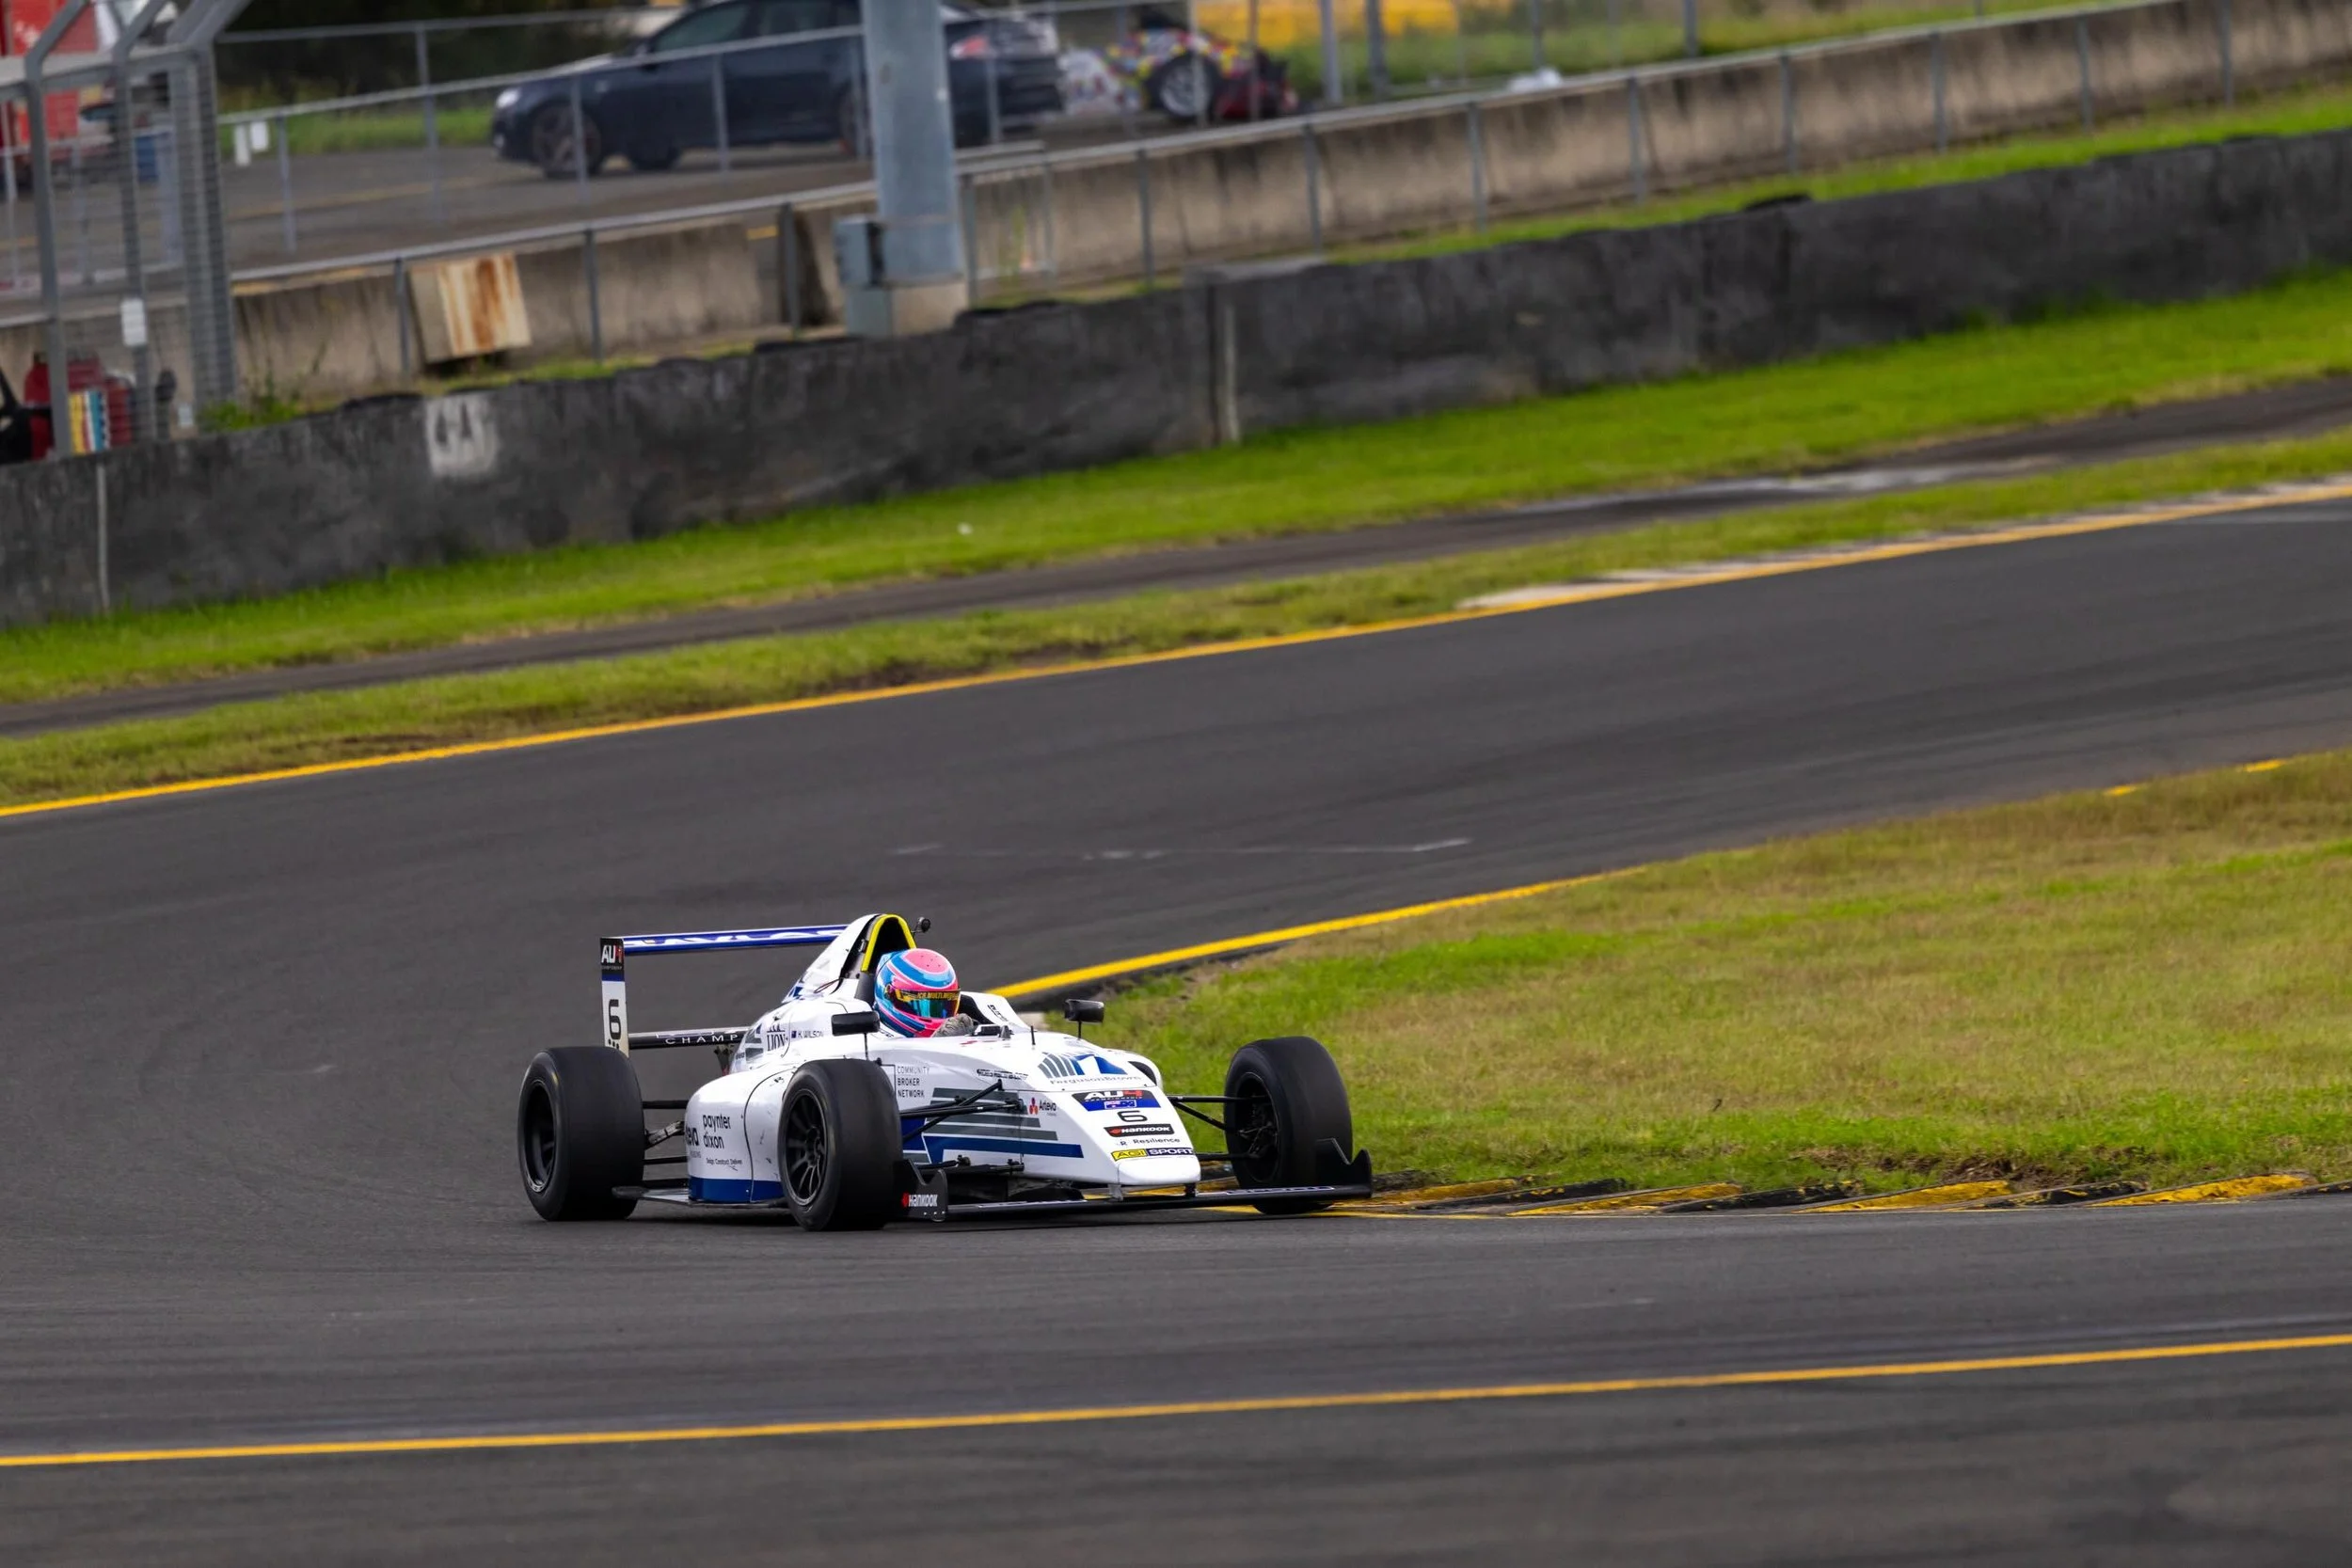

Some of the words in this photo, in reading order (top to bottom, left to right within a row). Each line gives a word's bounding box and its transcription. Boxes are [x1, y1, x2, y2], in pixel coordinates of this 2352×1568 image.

[609, 999, 622, 1040] 6
[767, 1033, 786, 1052] LION
[898, 1065, 930, 1074] COMMUNITY
[898, 1077, 920, 1086] BROKER
[898, 1089, 926, 1099] NETWORK
[703, 1114, 732, 1132] paynter
[1117, 1110, 1148, 1123] 6
[703, 1131, 725, 1149] dixon
[1148, 1148, 1195, 1156] SPORT
